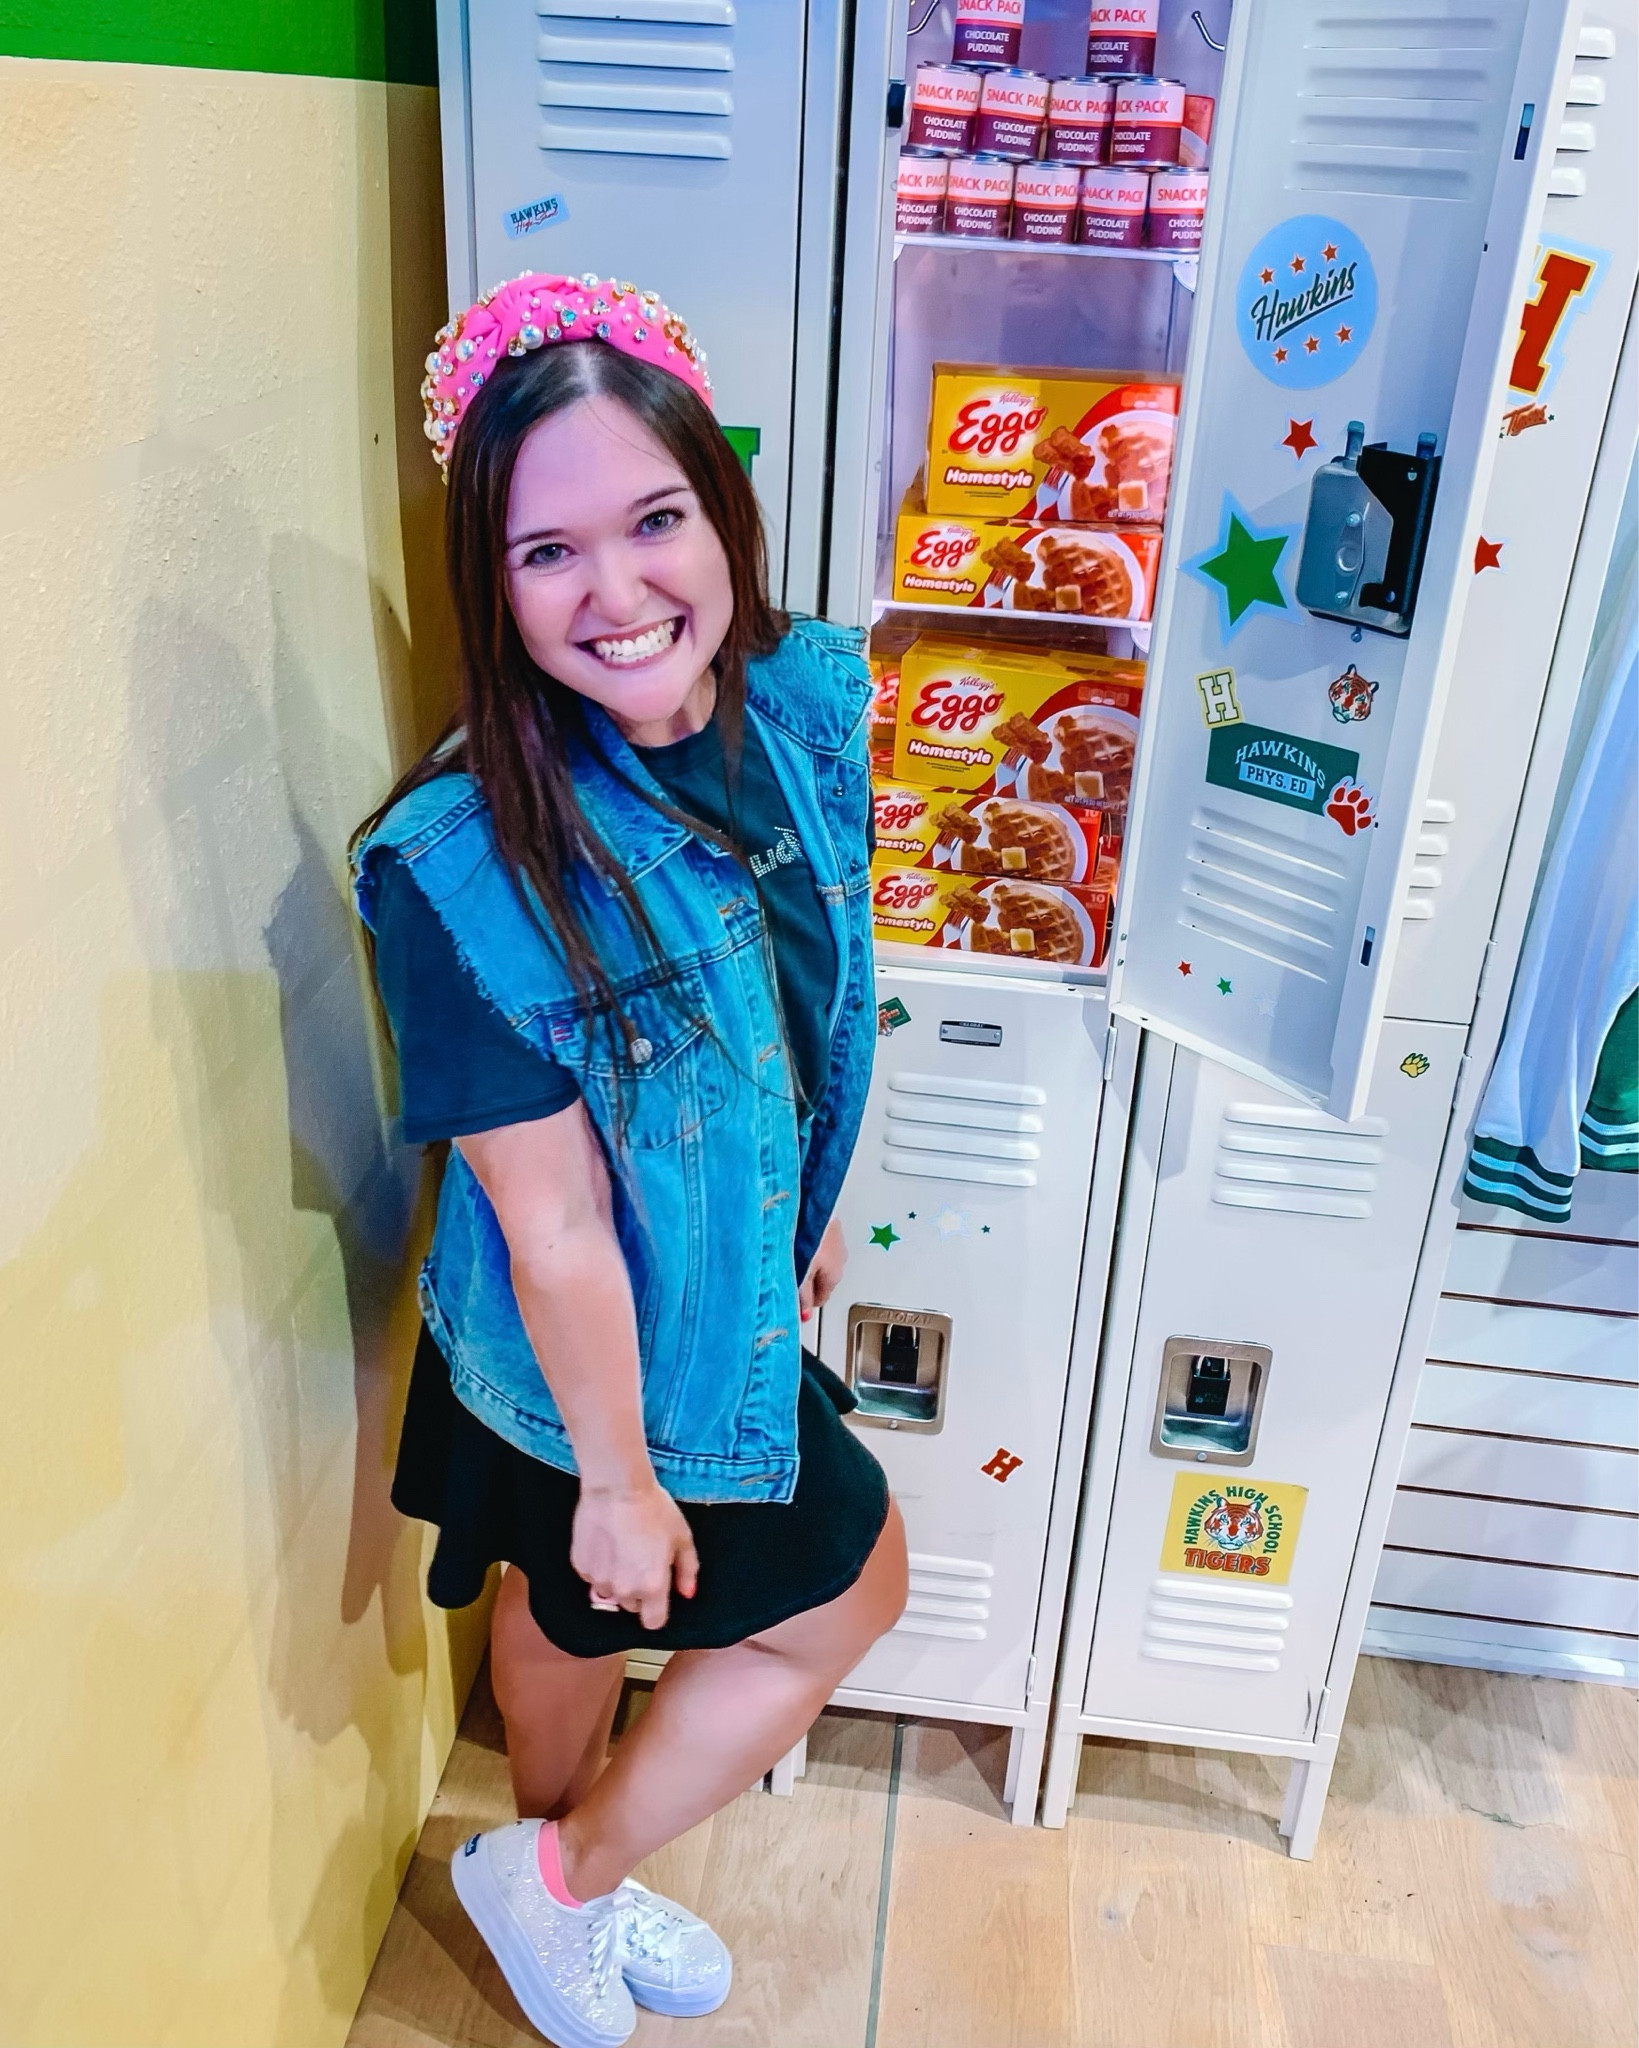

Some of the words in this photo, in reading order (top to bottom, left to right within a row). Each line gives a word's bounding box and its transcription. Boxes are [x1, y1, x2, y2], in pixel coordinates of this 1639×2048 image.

[1114, 9, 1147, 23] PACK
[965, 30, 1010, 42] CHOCOLATE
[967, 42, 1004, 54] PUDDING
[917, 83, 953, 100] SNACK
[986, 88, 1024, 105] SNACK
[1026, 94, 1048, 108] PAC
[1135, 100, 1168, 113] PACK
[923, 115, 967, 129] CHOCOLATE
[993, 120, 1036, 134] CHOCOLATE
[925, 127, 962, 141] PUDDING
[995, 133, 1031, 146] PUDDING
[1055, 129, 1099, 141] CHOCOLATE
[1057, 142, 1095, 153] PUDDING
[1017, 182, 1051, 197] SNACK
[1158, 188, 1198, 201] SNACK
[510, 198, 558, 224] HAWKINS
[954, 206, 997, 218] CHOCOLATE
[1023, 212, 1067, 223] CHOCOLATE
[898, 214, 933, 225] PUDDING
[957, 218, 992, 230] PUDDING
[1086, 216, 1129, 229] CHOCOLATE
[1026, 225, 1062, 235] PUDDING
[1088, 228, 1124, 240] PUDDING
[1251, 262, 1358, 341] Hawkins
[948, 399, 1046, 455] Eggo
[945, 467, 1033, 490] Homestyle
[911, 530, 981, 568] Eggo
[904, 576, 976, 595] Homestyle
[1198, 671, 1240, 725] H
[911, 680, 1005, 732] Eggo
[909, 740, 992, 765] Homestyle
[1235, 740, 1326, 790] HAWKINS
[1246, 765, 1287, 789] PHYS.
[1290, 778, 1308, 795] ED
[873, 876, 939, 909] Eggo
[1091, 893, 1106, 904] 10
[981, 1447, 1024, 1484] H
[1184, 1489, 1220, 1545] HAWKINS
[1225, 1486, 1269, 1504] HIGH
[1263, 1504, 1283, 1554] SCHOOL
[1184, 1547, 1272, 1577] TIGERS
